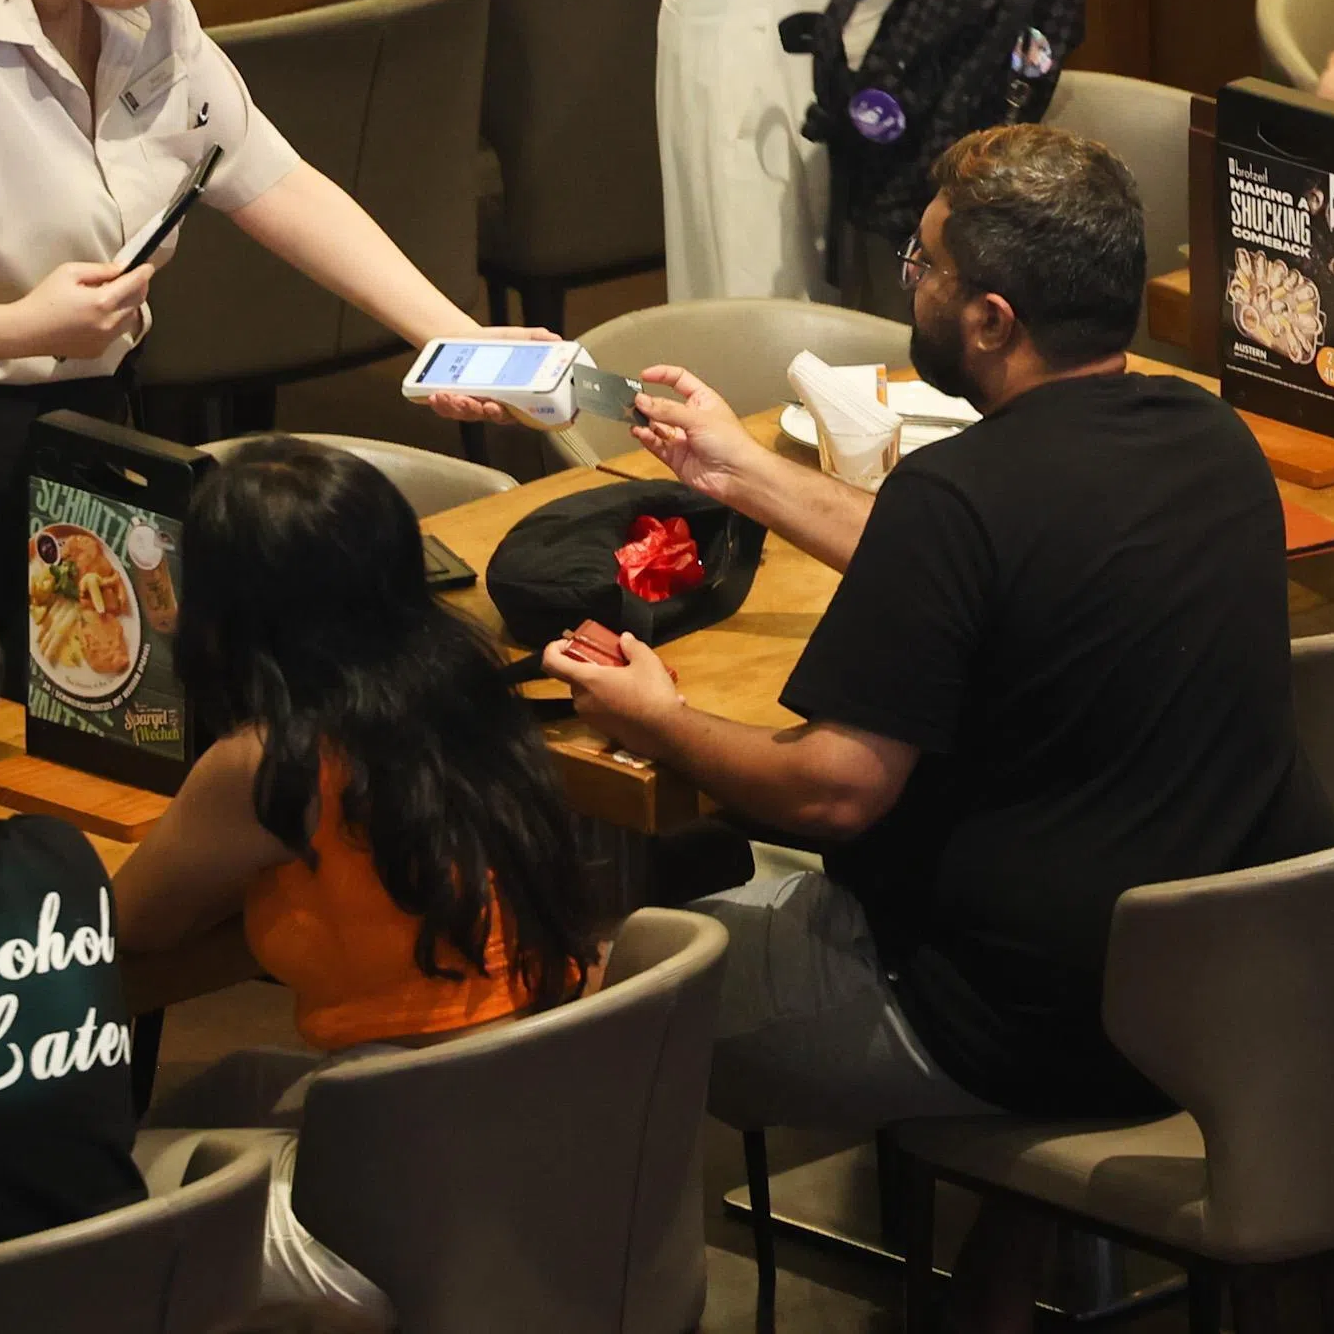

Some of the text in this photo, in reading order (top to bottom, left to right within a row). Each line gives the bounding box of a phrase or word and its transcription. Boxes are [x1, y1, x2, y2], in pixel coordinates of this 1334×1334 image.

[1229, 176, 1310, 212] MAKING A
[1230, 190, 1312, 246] SHUCKING
[1231, 225, 1312, 260] COMEBACK
[1233, 341, 1268, 360] AUSTERN
